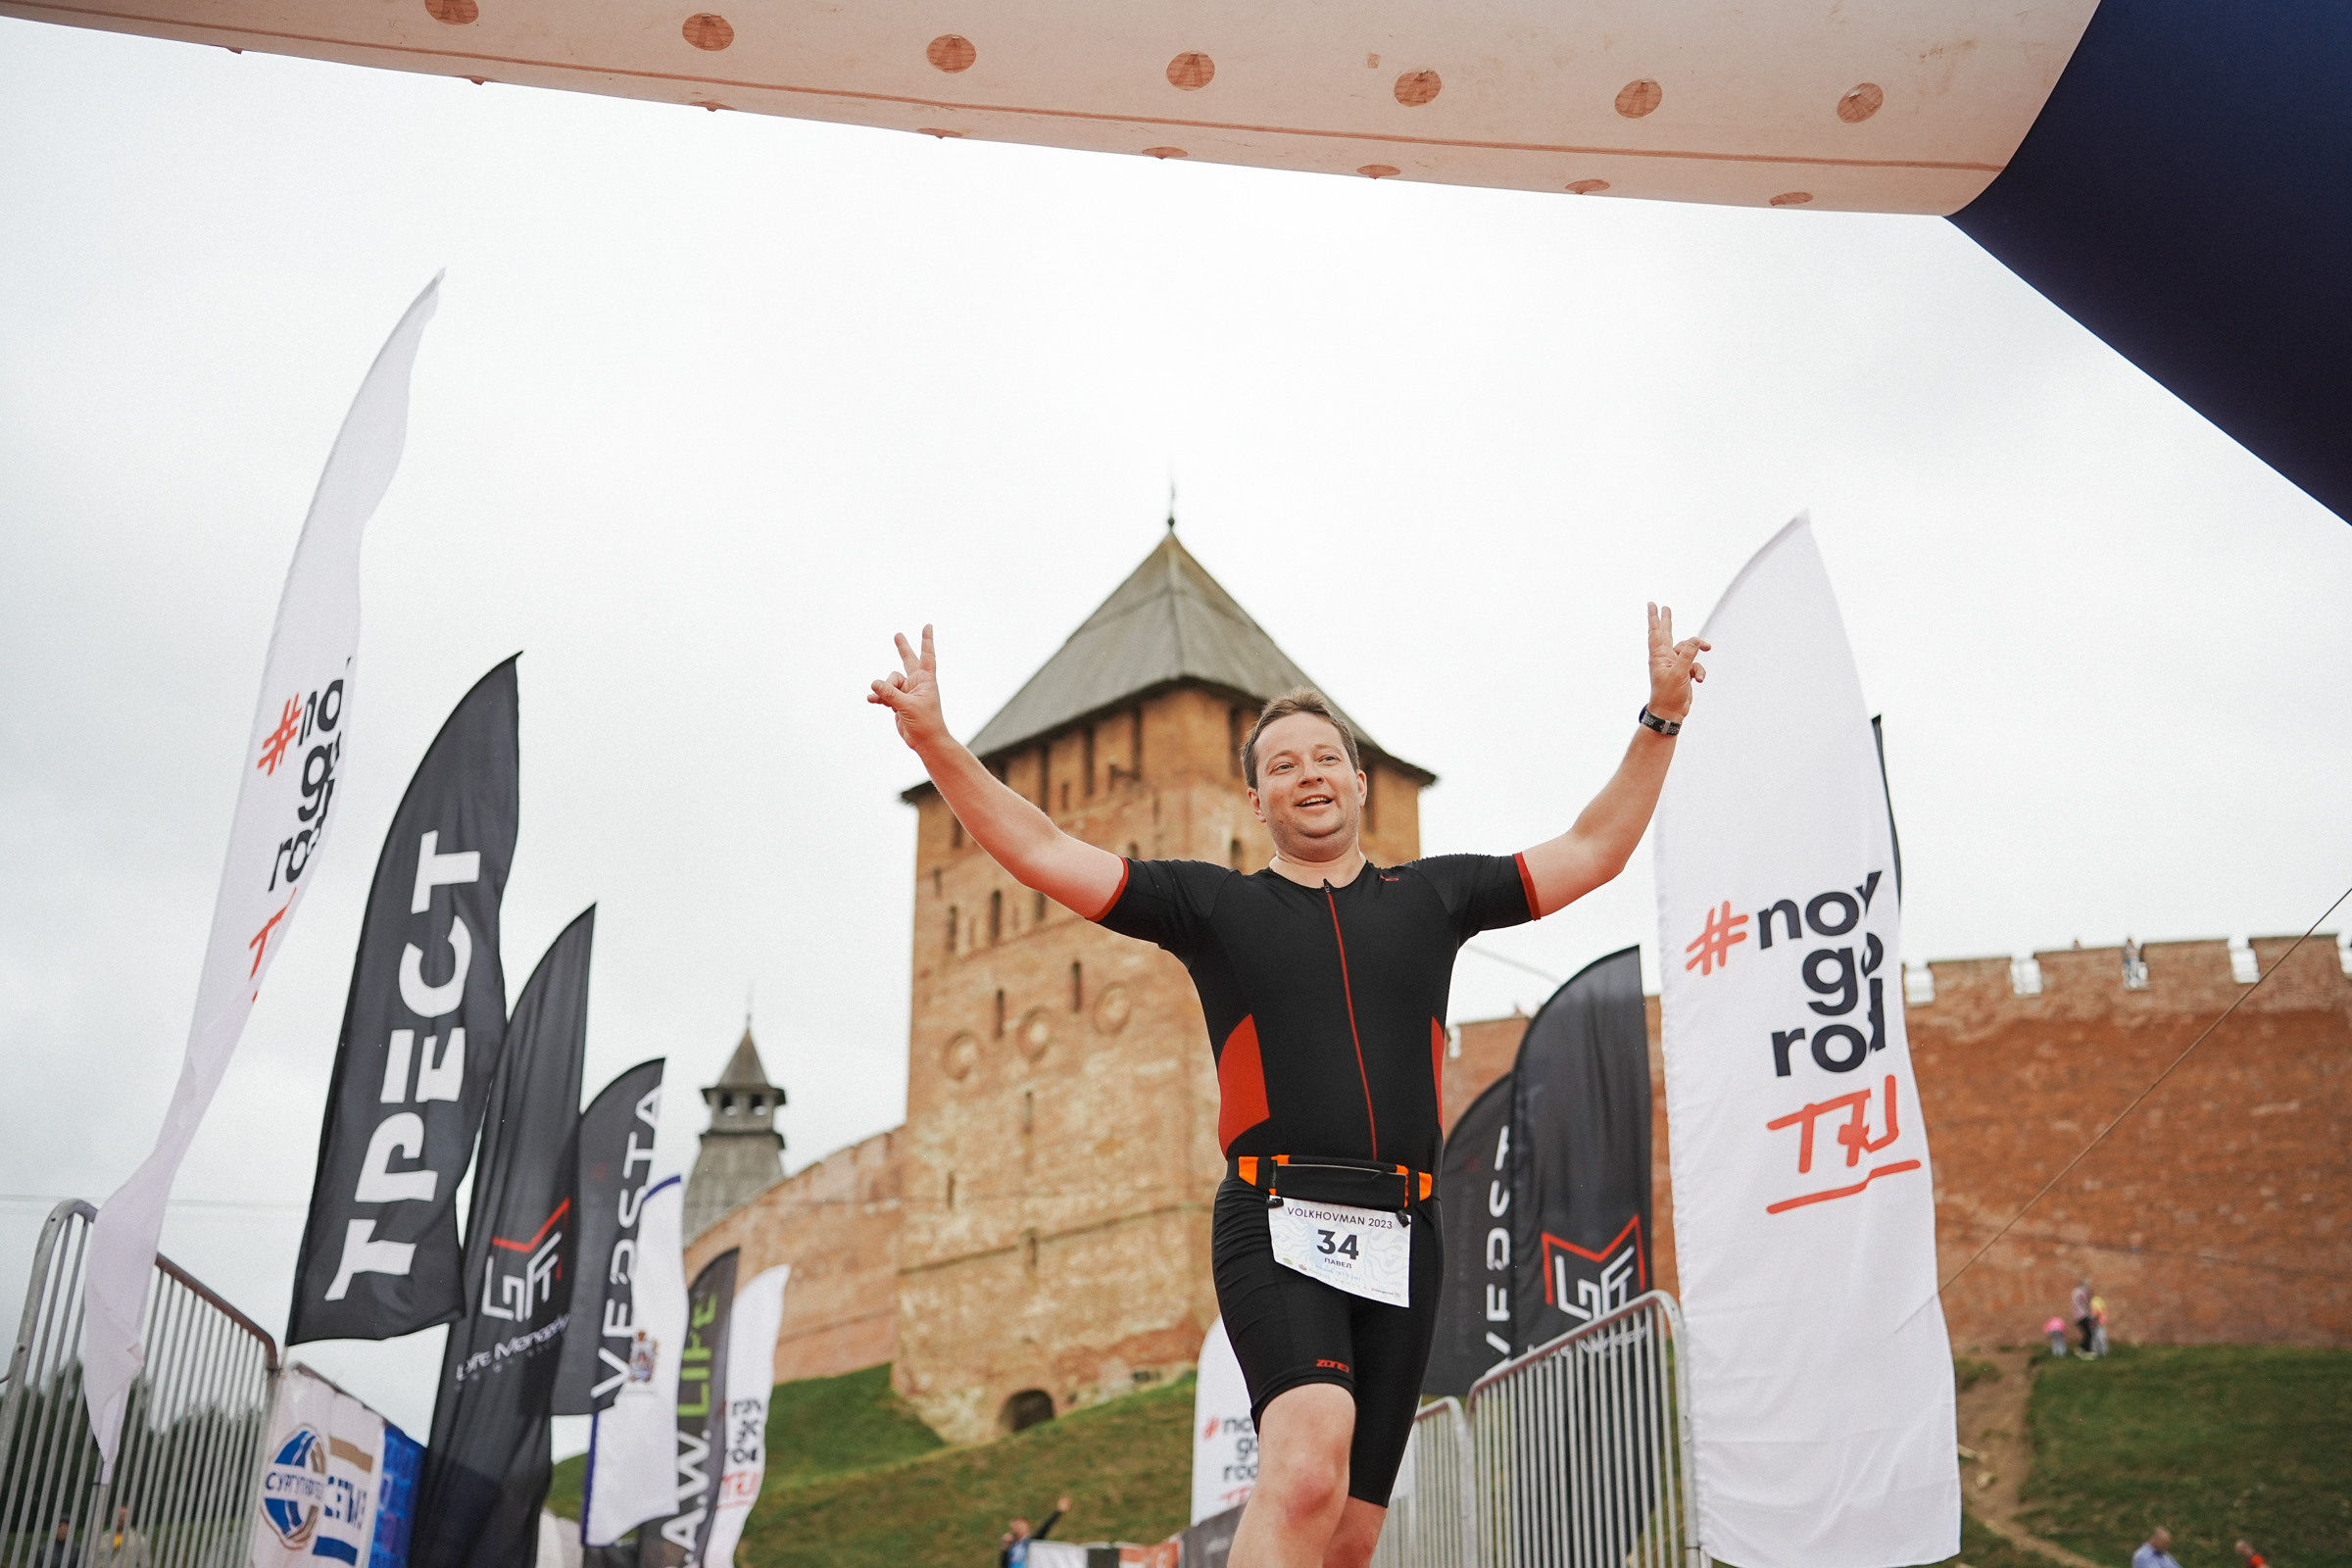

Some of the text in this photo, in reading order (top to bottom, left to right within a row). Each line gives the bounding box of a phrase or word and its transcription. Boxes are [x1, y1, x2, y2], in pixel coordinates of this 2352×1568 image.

[257, 657, 351, 777] #no
[1287, 1206, 1393, 1230] VOLKHOVMAN 2023
[1316, 1229, 1359, 1260] 34
[1324, 1257, 1352, 1269] ПАВЕЛ
